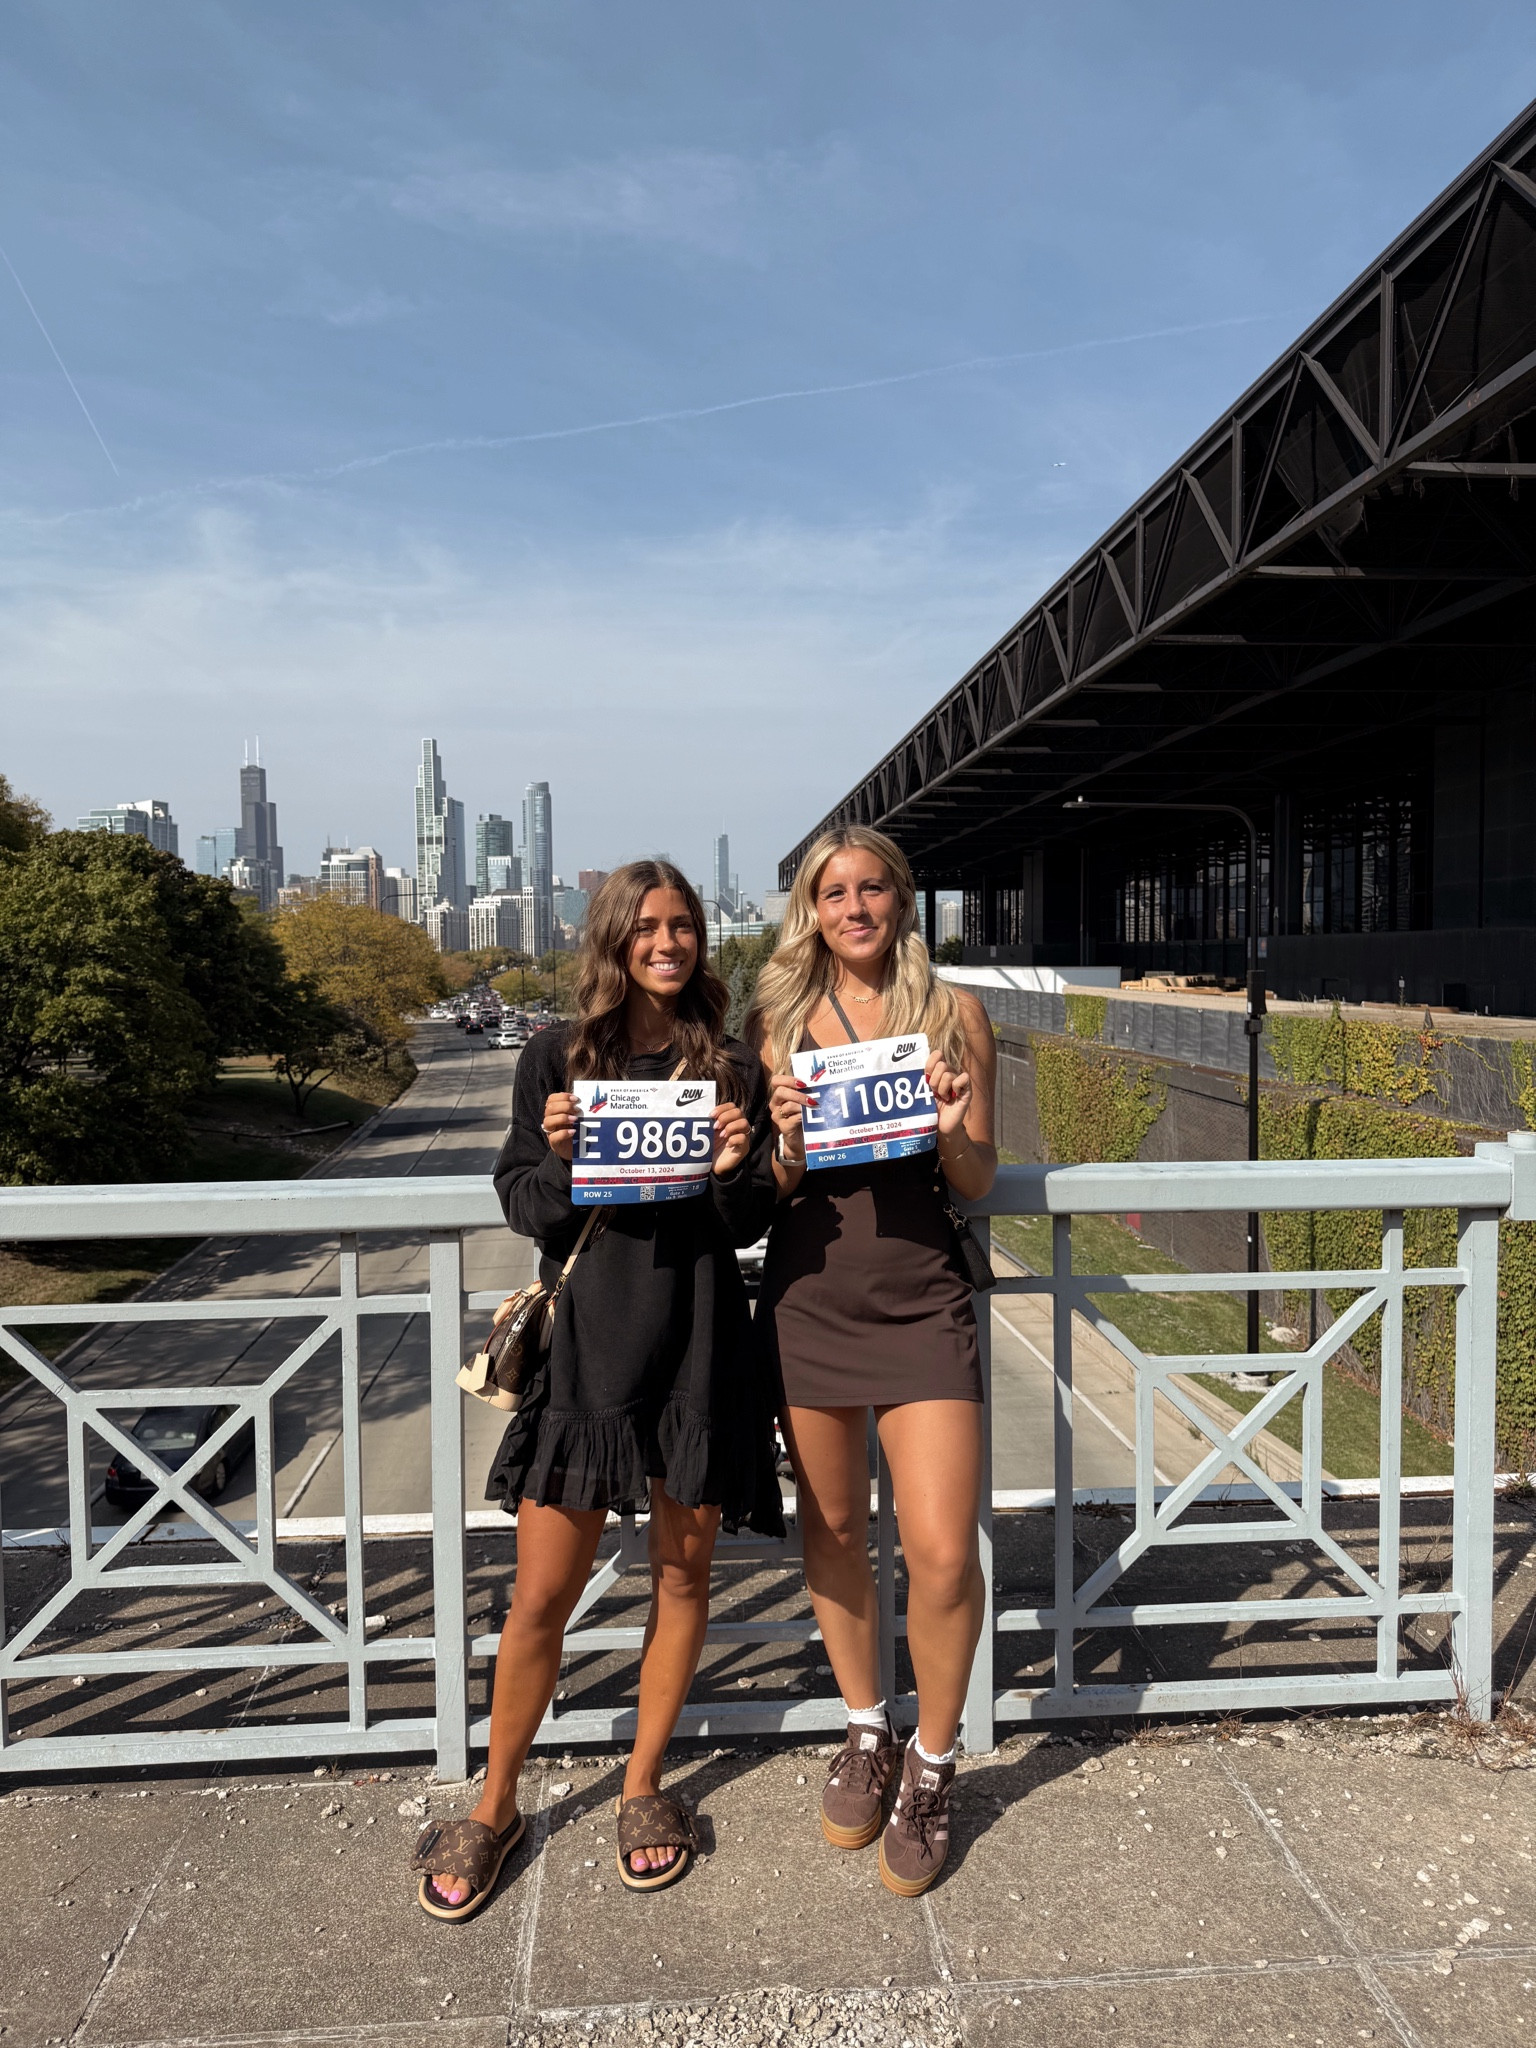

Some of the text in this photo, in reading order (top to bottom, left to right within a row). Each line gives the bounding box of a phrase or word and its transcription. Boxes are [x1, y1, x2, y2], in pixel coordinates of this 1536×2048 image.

[896, 1042, 917, 1053] RUN
[828, 1058, 857, 1067] Chicago
[610, 1094, 640, 1103] Chicago
[681, 1089, 703, 1099] RUN
[834, 1074, 934, 1119] 11084
[849, 1127, 874, 1135] October
[579, 1120, 711, 1159] E 9865
[818, 1154, 835, 1162] ROW
